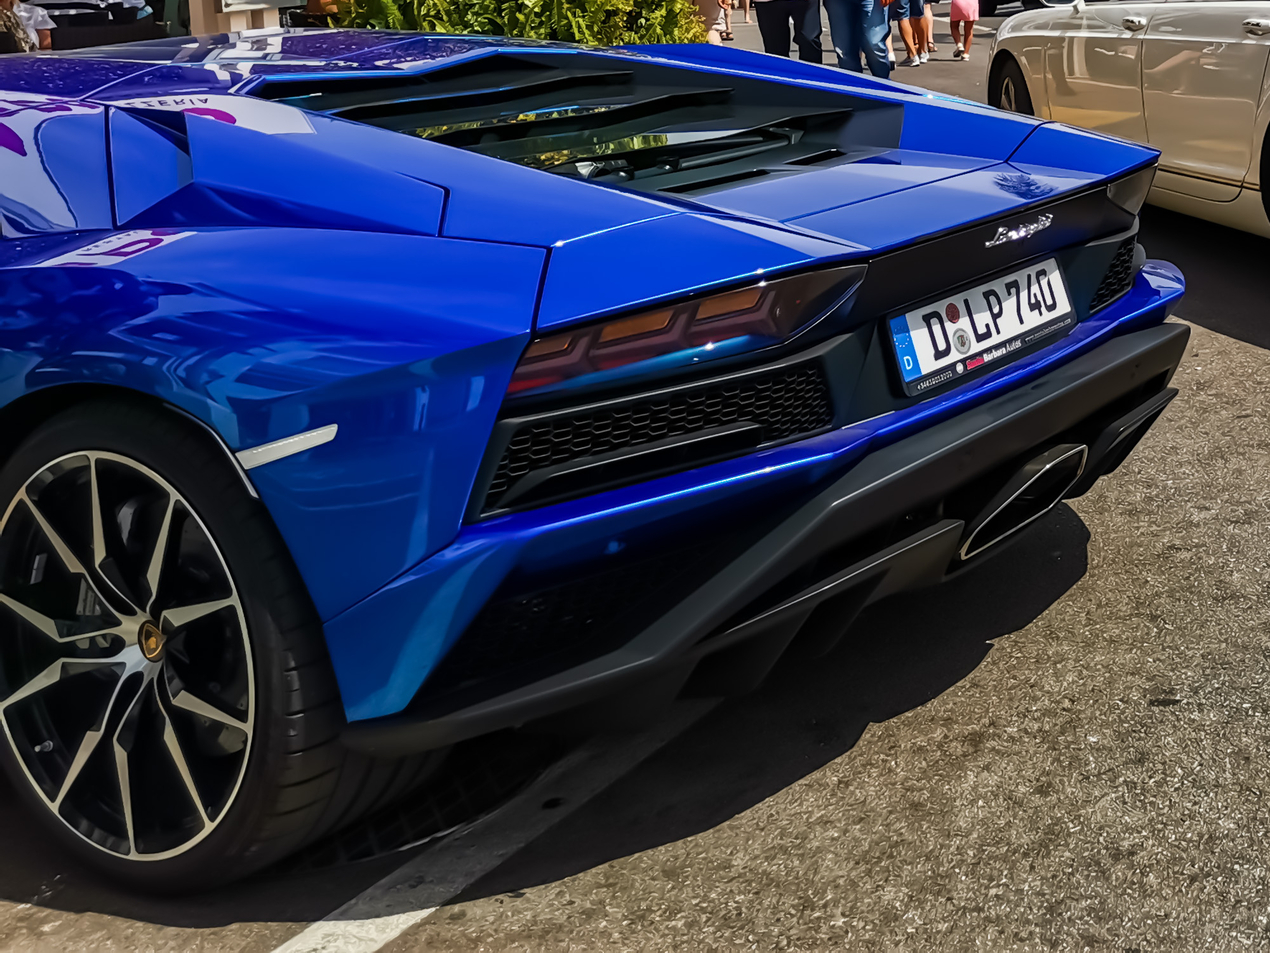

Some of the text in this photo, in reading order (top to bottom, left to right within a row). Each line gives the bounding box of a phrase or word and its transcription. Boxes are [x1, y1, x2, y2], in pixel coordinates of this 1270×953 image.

[922, 310, 952, 362] D
[963, 288, 1004, 344] LP
[1004, 268, 1057, 326] 740
[903, 356, 913, 370] D
